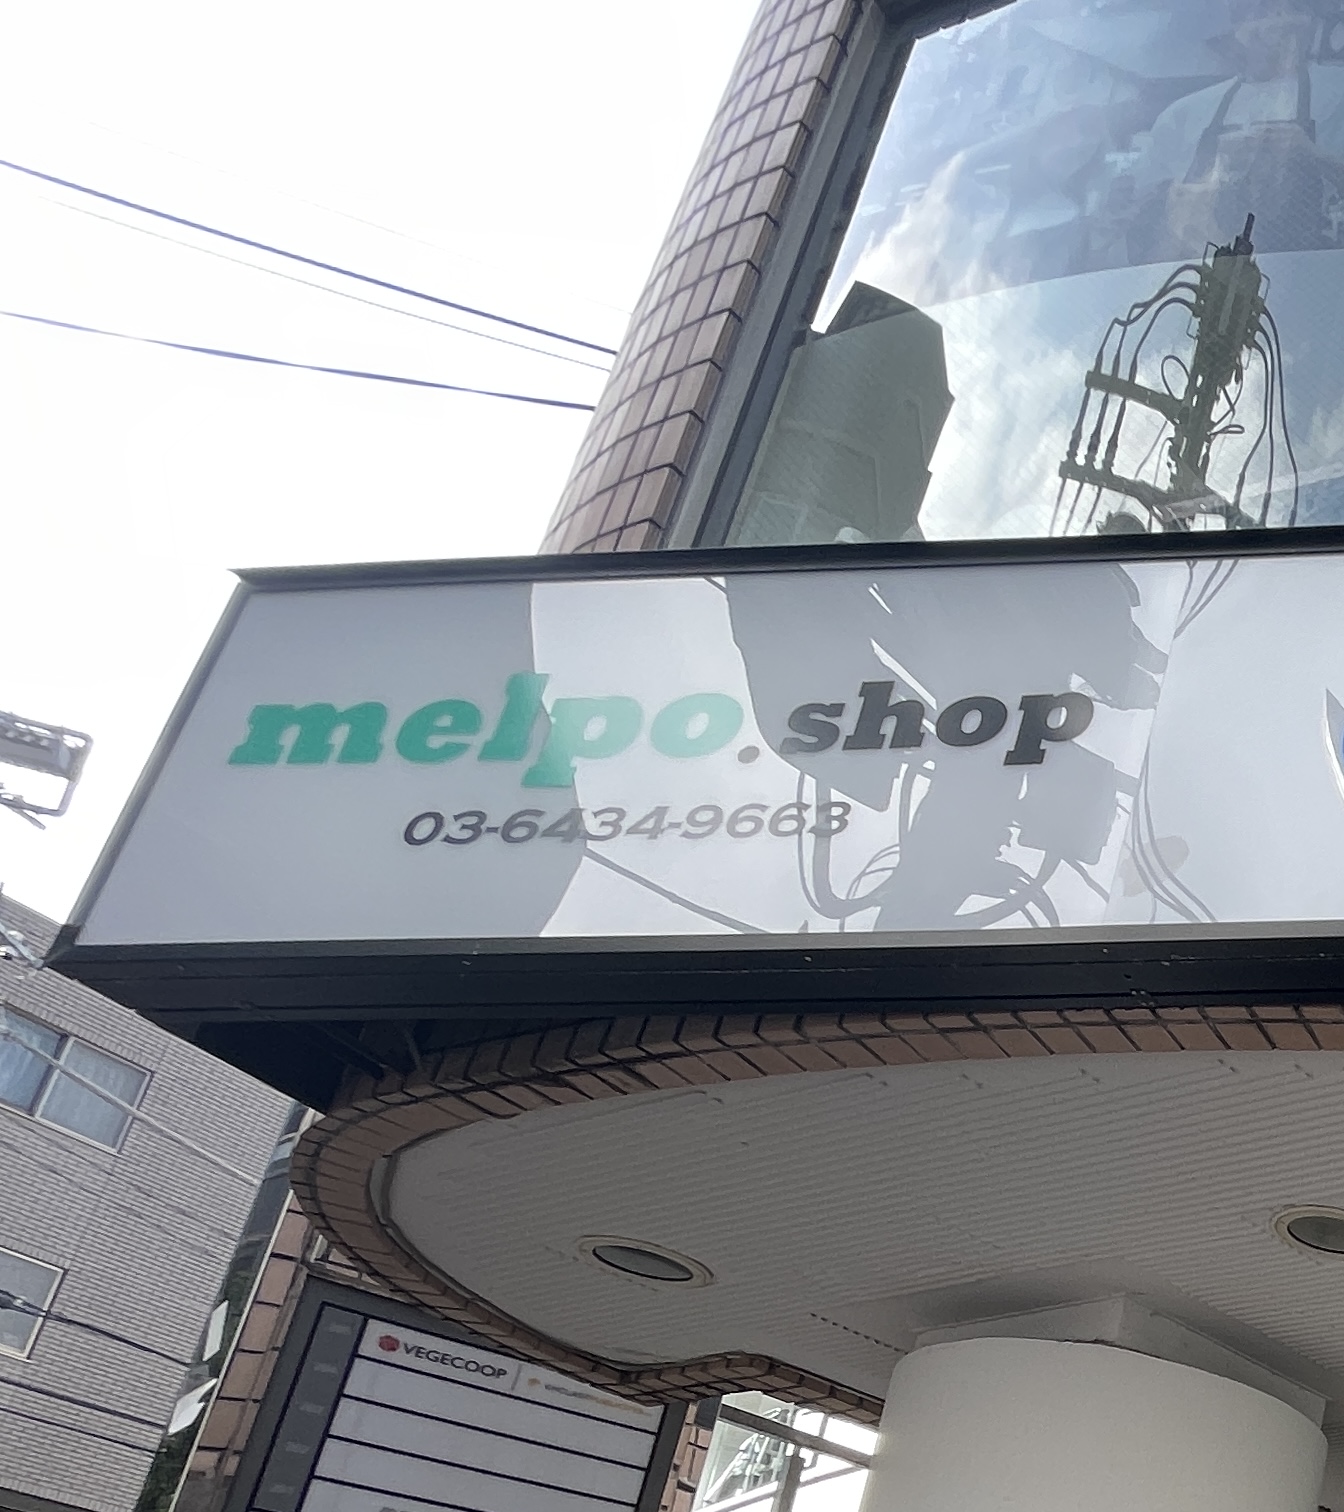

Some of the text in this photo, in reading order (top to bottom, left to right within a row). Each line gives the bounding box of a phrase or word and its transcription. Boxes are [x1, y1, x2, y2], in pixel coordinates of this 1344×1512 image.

[228, 669, 1094, 788] melpo.shop
[404, 801, 851, 846] 03-6434-9663
[403, 1342, 508, 1380] VEGECOOP
